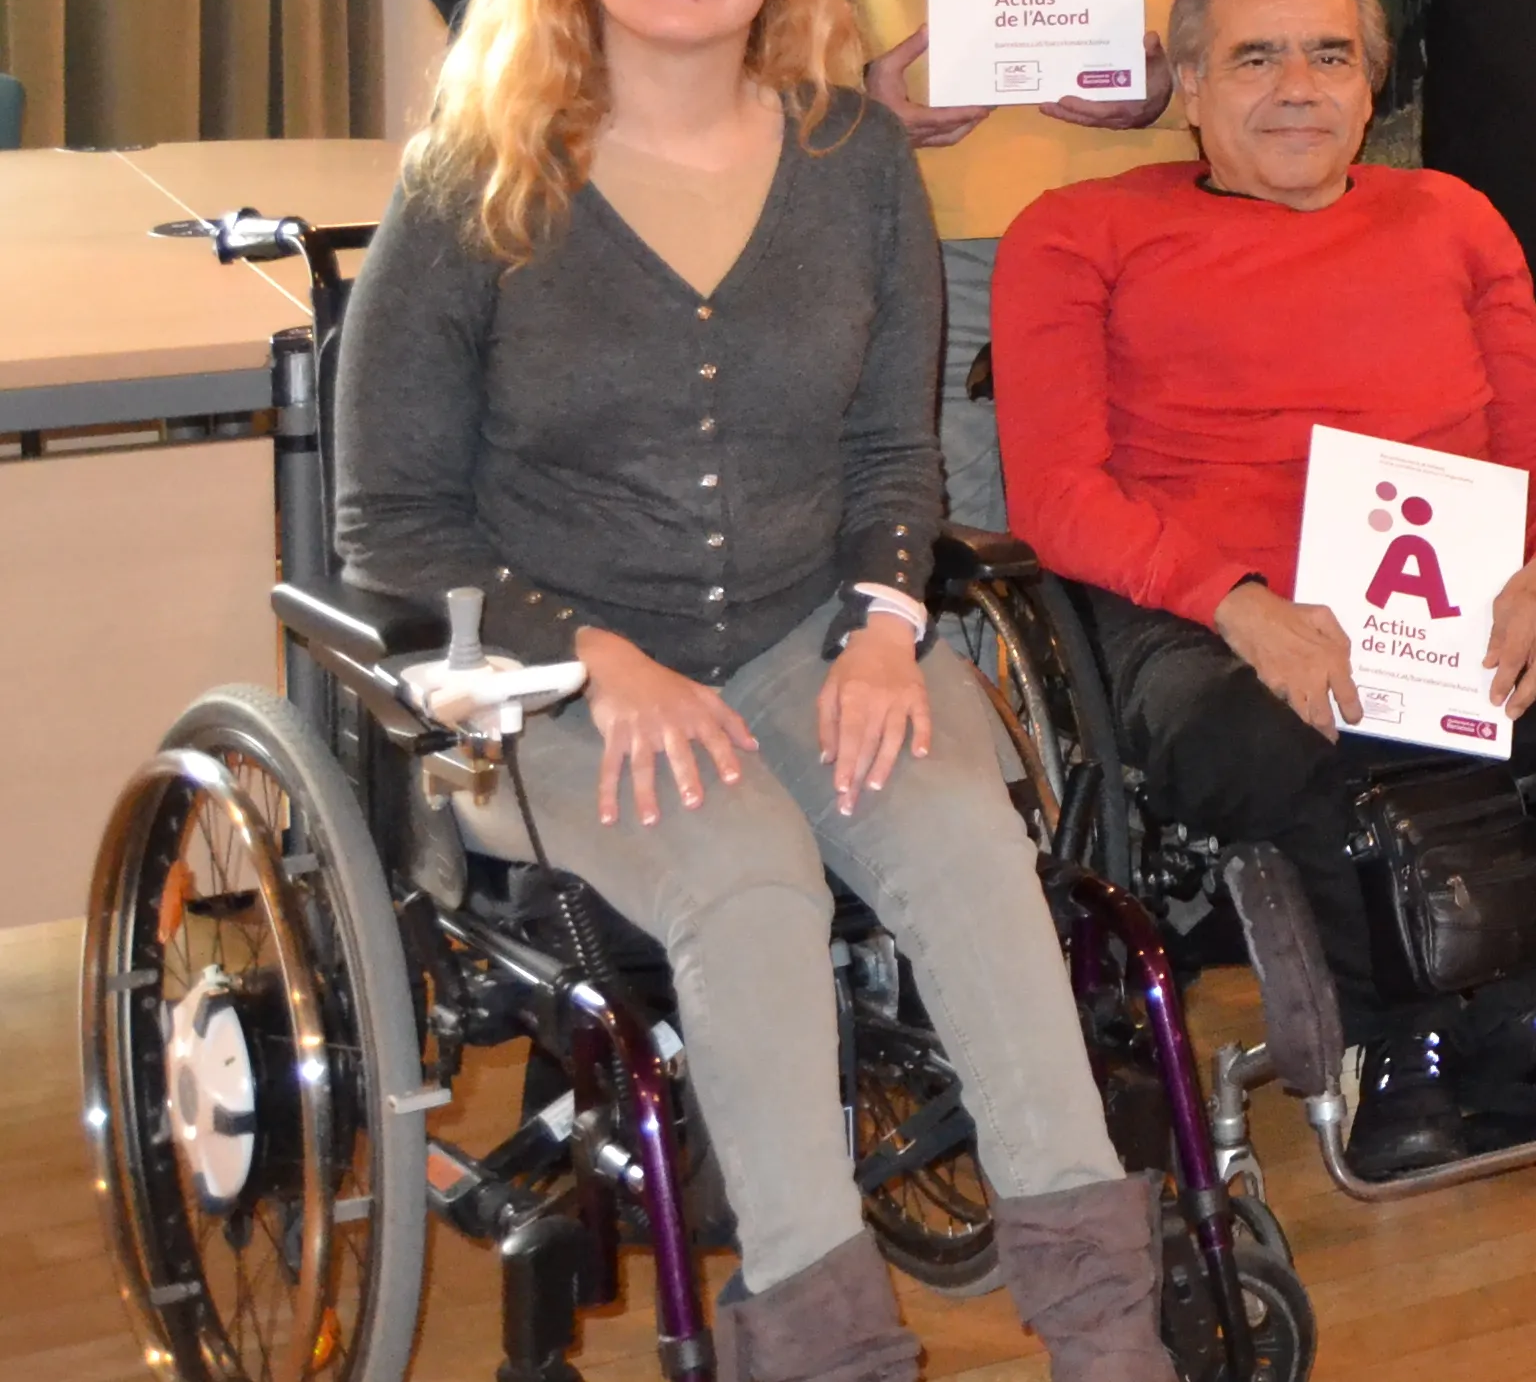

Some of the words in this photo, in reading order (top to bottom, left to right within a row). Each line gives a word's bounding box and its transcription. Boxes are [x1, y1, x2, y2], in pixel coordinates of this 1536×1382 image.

[995, 11, 1018, 27] de
[1023, 8, 1089, 26] l'Acord
[1363, 615, 1426, 640] Actius
[1362, 635, 1386, 653] de
[1391, 639, 1460, 667] l'Acord
